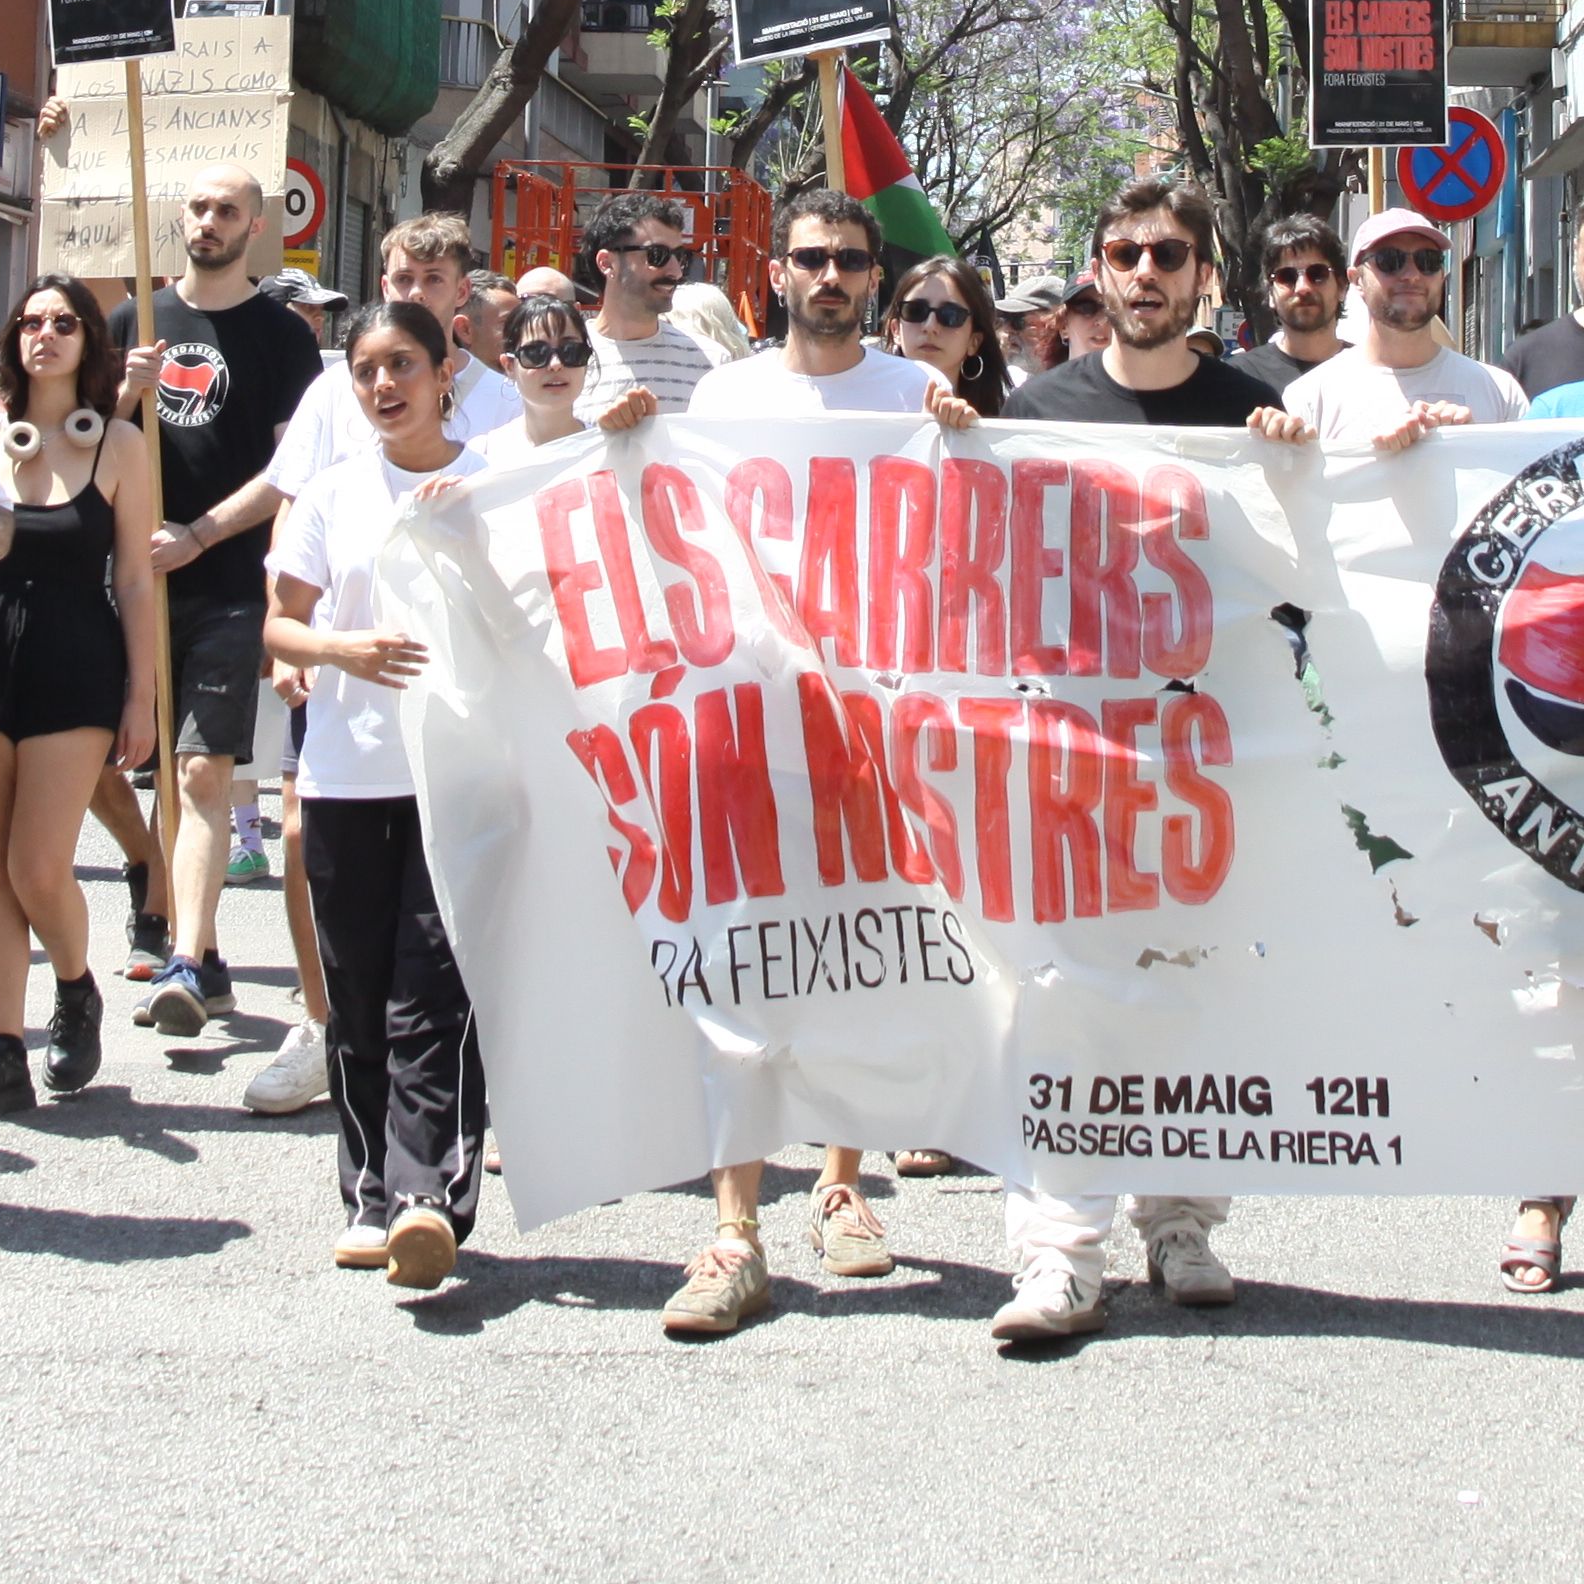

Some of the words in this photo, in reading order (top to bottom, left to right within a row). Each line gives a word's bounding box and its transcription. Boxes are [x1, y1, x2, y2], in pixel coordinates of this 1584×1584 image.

[1325, 0, 1355, 34] ELS
[1357, 0, 1432, 34] CARRERS
[254, 36, 273, 54] A
[1361, 36, 1434, 71] NOSTRES
[73, 79, 116, 98] LOS
[142, 68, 214, 94] NAZIS
[225, 70, 278, 92] COMO
[1324, 73, 1346, 87] FORA
[1347, 72, 1387, 87] FEIXISTES
[72, 112, 87, 136] A
[111, 108, 158, 137] LS
[165, 106, 273, 131] ANCIANXS
[67, 149, 107, 173] QUE
[285, 187, 306, 216] 0
[162, 345, 225, 372] ERDANYOLA
[535, 461, 739, 689] ELS
[724, 453, 1214, 679] CARRERS
[565, 664, 786, 924] SÓN
[650, 939, 713, 1008] RA
[727, 905, 977, 1006] FEIXISTES
[1028, 1073, 1073, 1113] 31
[1088, 1074, 1145, 1115] DE
[1153, 1073, 1273, 1116] MAIG
[1305, 1076, 1390, 1118] 12H
[1022, 1113, 1153, 1159] PASSEIG
[1162, 1126, 1211, 1160] DE
[1218, 1128, 1265, 1161] LA
[1270, 1130, 1380, 1167] RIERA
[1386, 1134, 1403, 1166] 1
